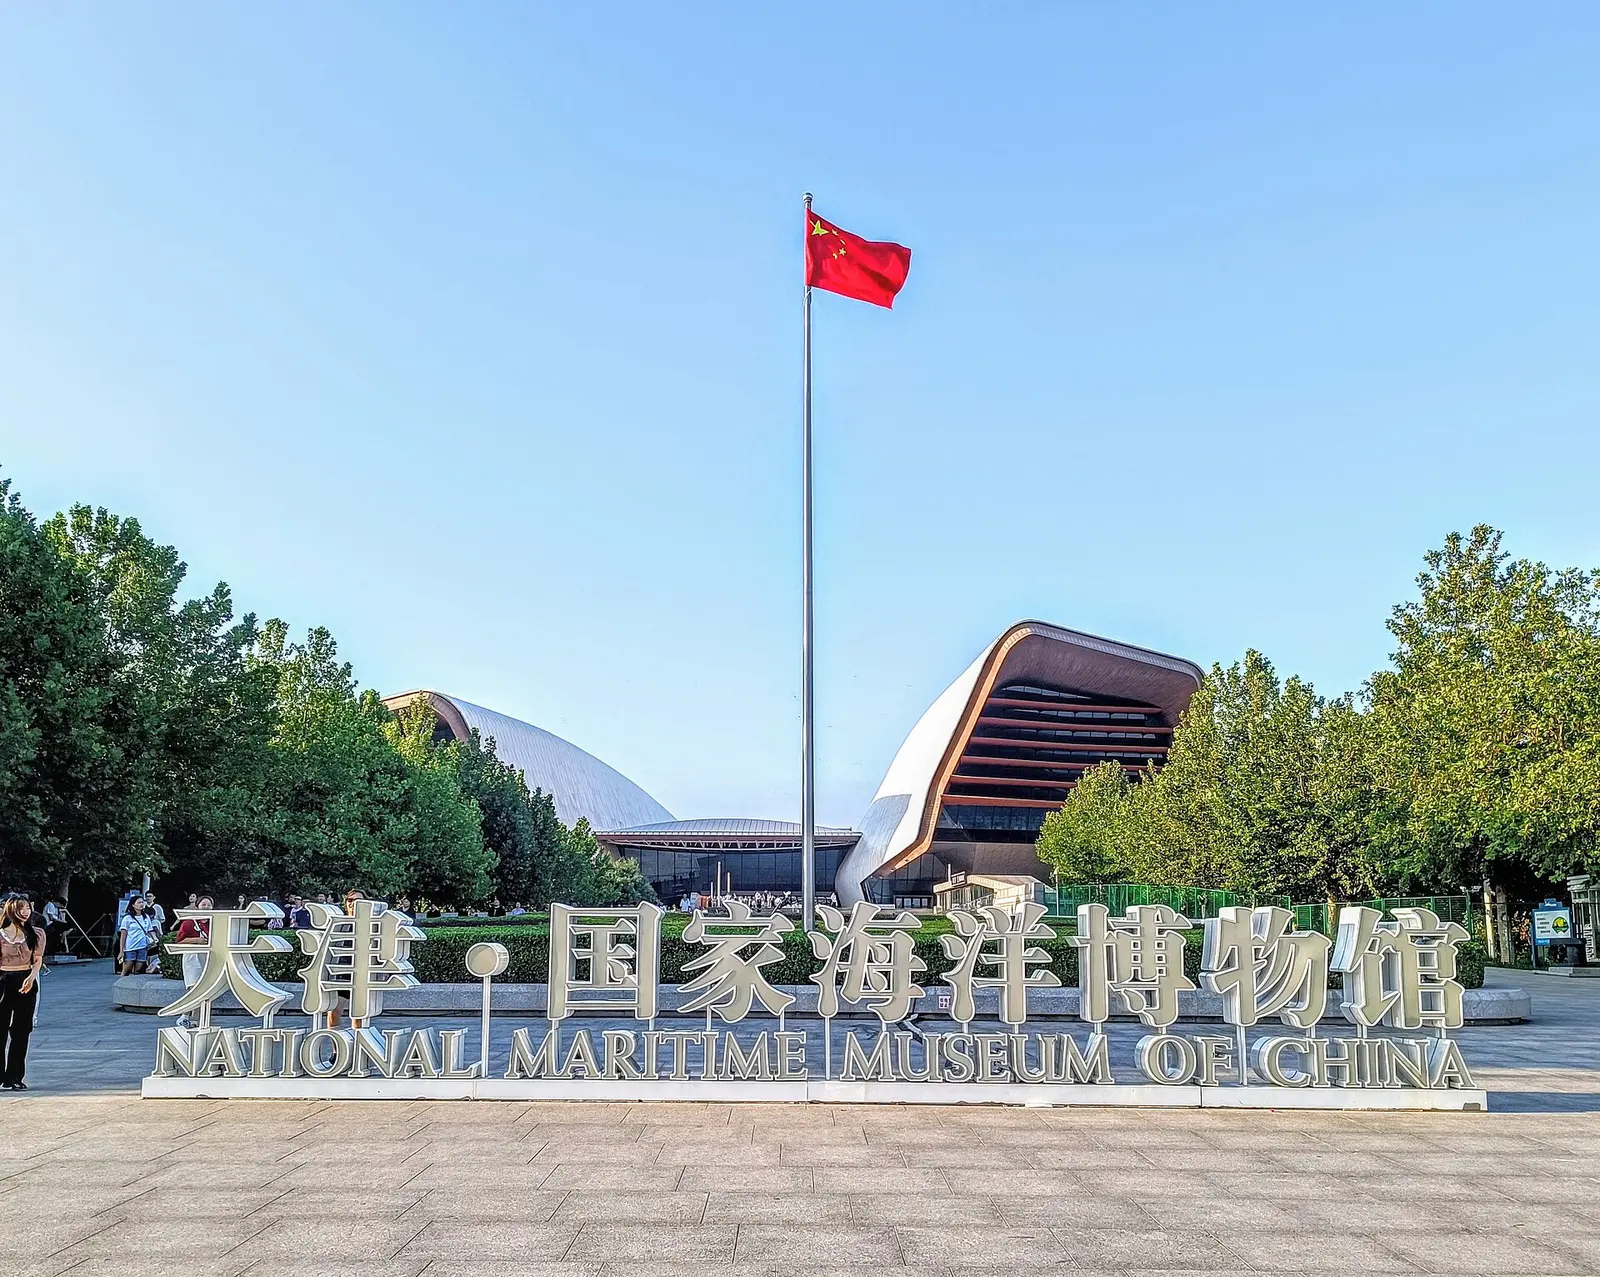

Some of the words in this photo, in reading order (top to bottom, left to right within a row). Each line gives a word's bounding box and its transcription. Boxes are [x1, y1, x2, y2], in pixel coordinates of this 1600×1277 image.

[152, 1026, 481, 1079] NATIONAL
[503, 1026, 808, 1082] MARITIME
[840, 1031, 1115, 1085] MUSEUM
[1134, 1034, 1234, 1087] OF
[1250, 1035, 1478, 1090] CHINA
